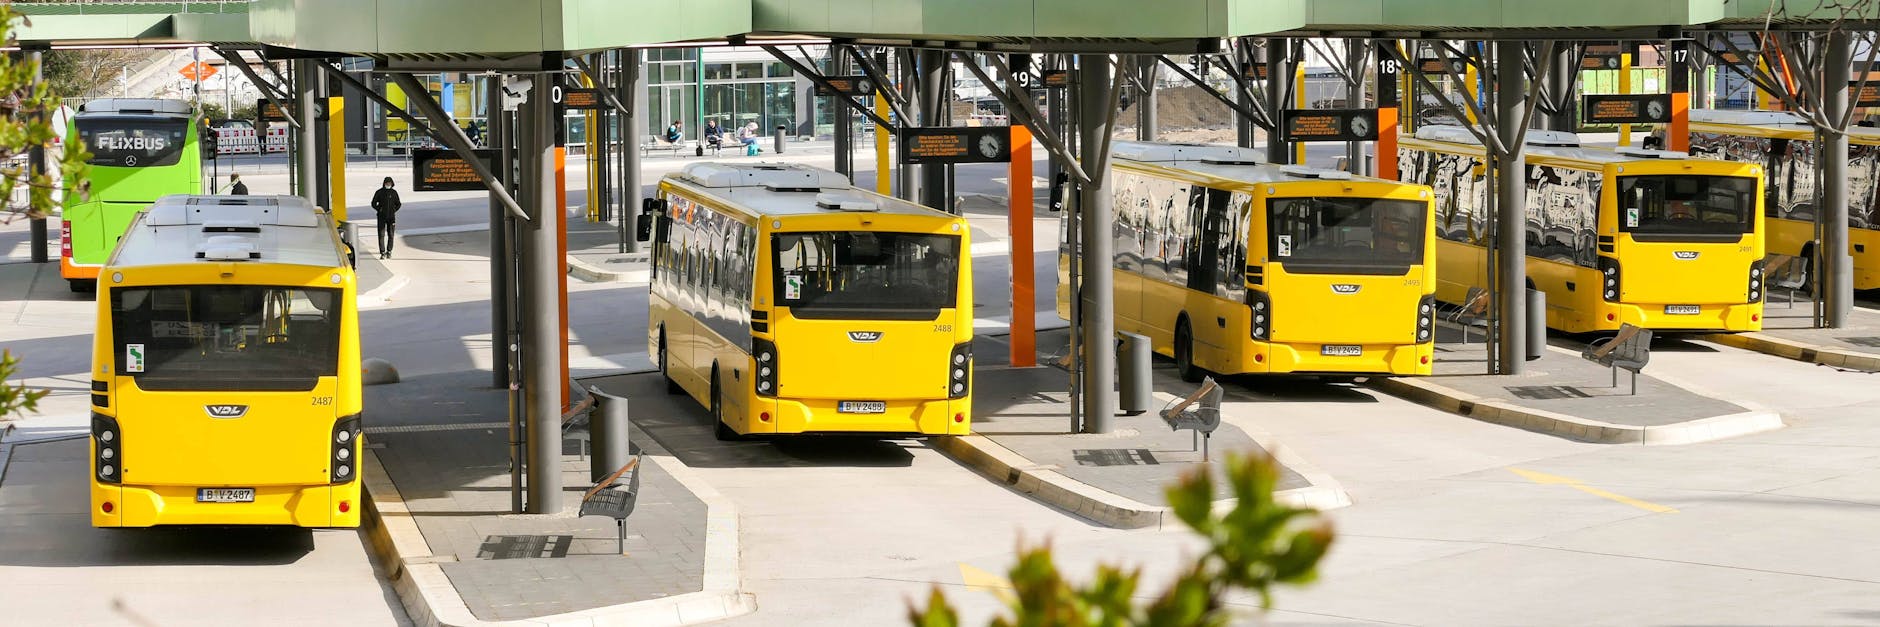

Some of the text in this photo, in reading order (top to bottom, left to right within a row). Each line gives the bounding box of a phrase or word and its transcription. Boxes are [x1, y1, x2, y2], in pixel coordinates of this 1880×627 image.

[1674, 49, 1688, 63] 17
[1380, 59, 1395, 74] 18
[1012, 71, 1029, 88] 19
[933, 324, 952, 332] 2488
[852, 332, 877, 340] VDL
[312, 396, 333, 406] 2487
[211, 406, 241, 415] VDL
